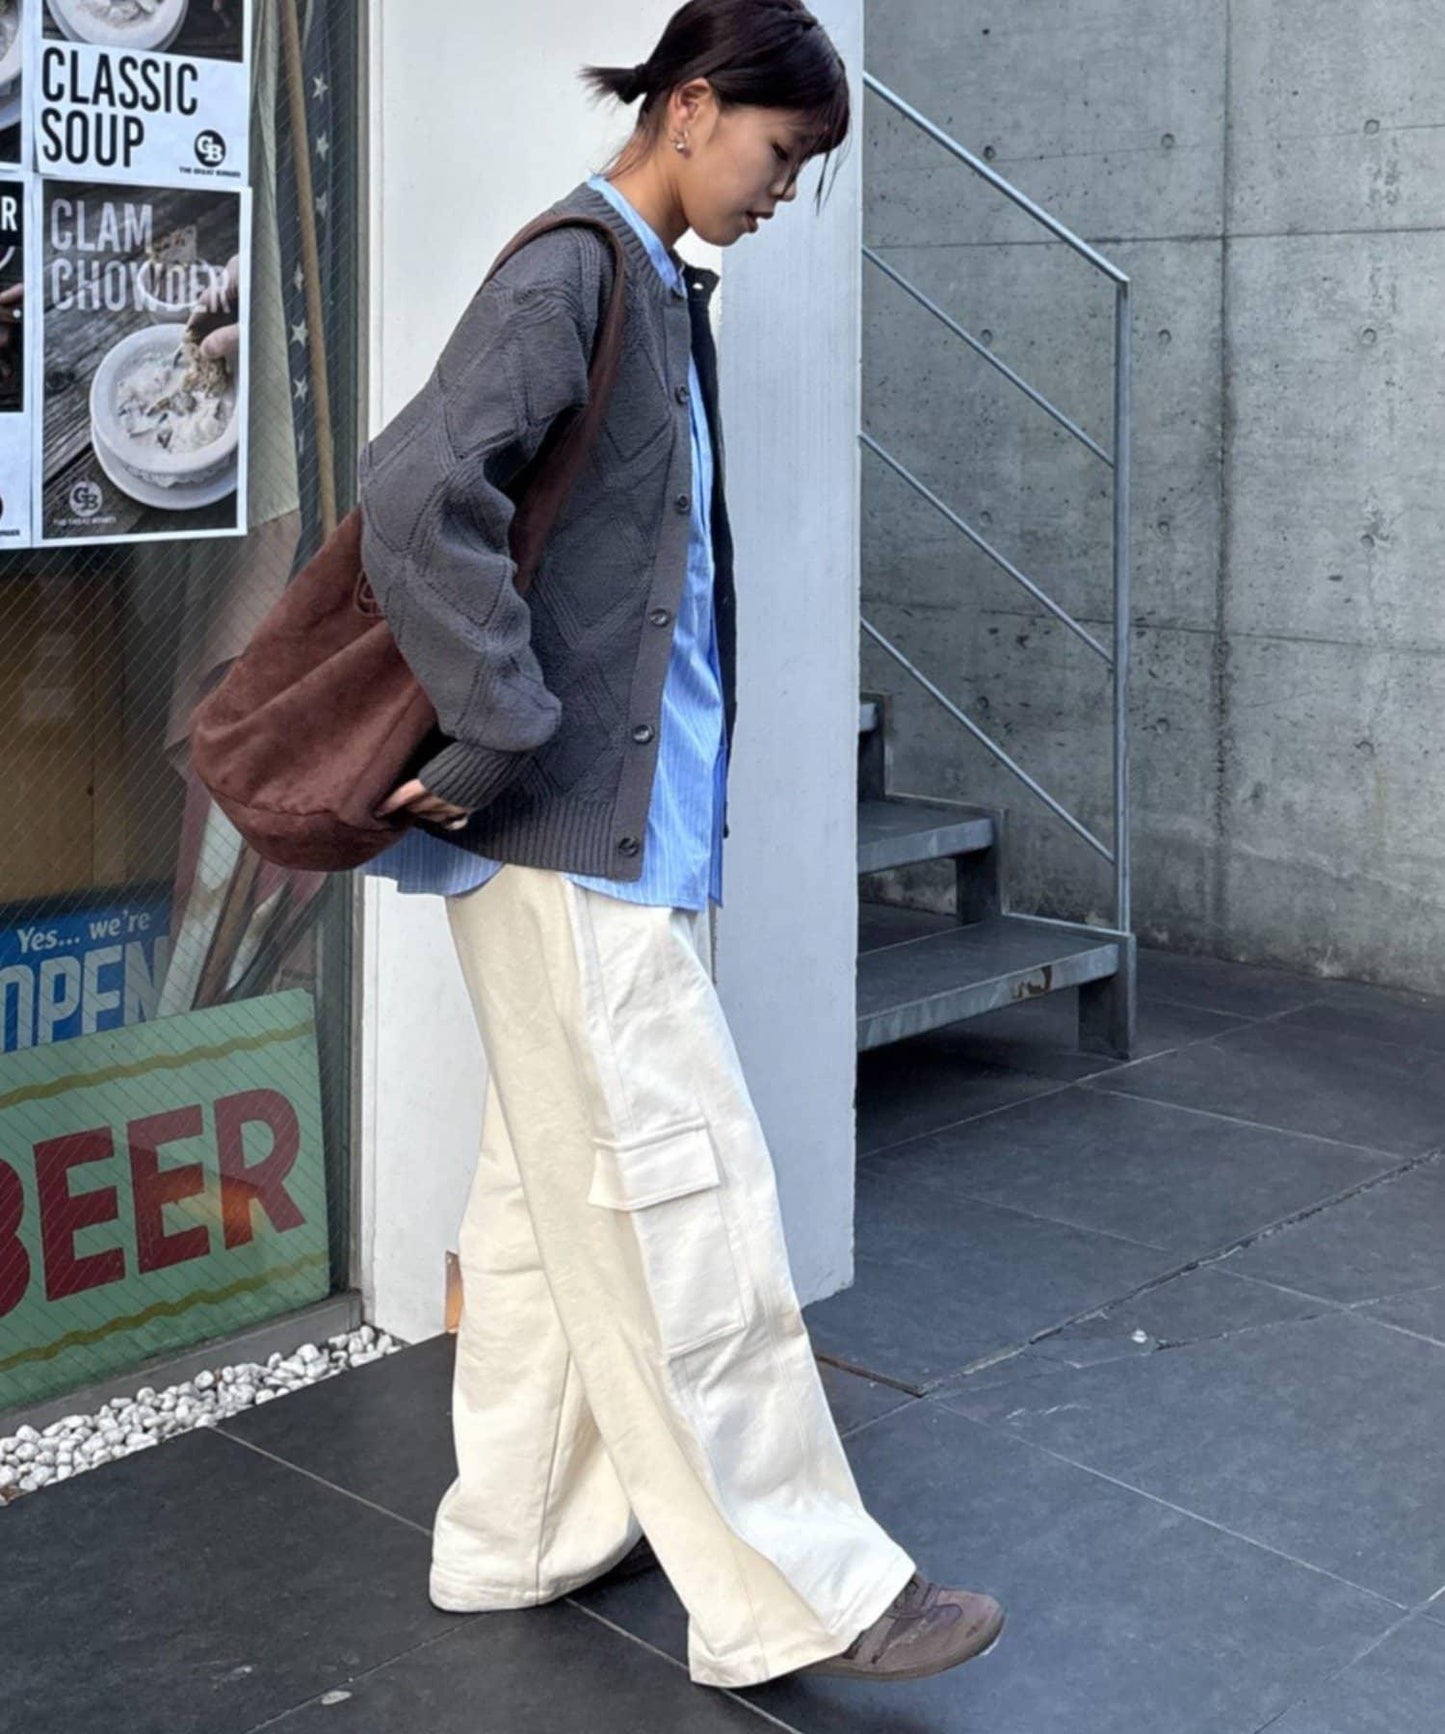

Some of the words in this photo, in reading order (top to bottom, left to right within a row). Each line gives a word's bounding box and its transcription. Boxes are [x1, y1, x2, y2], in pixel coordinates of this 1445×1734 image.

[42, 46, 198, 116] CLASSIC
[41, 107, 145, 168] SOUP
[51, 198, 153, 254] CLAM
[51, 258, 231, 314] CHOWDER
[16, 926, 81, 954] Yes...
[89, 909, 150, 940] we're
